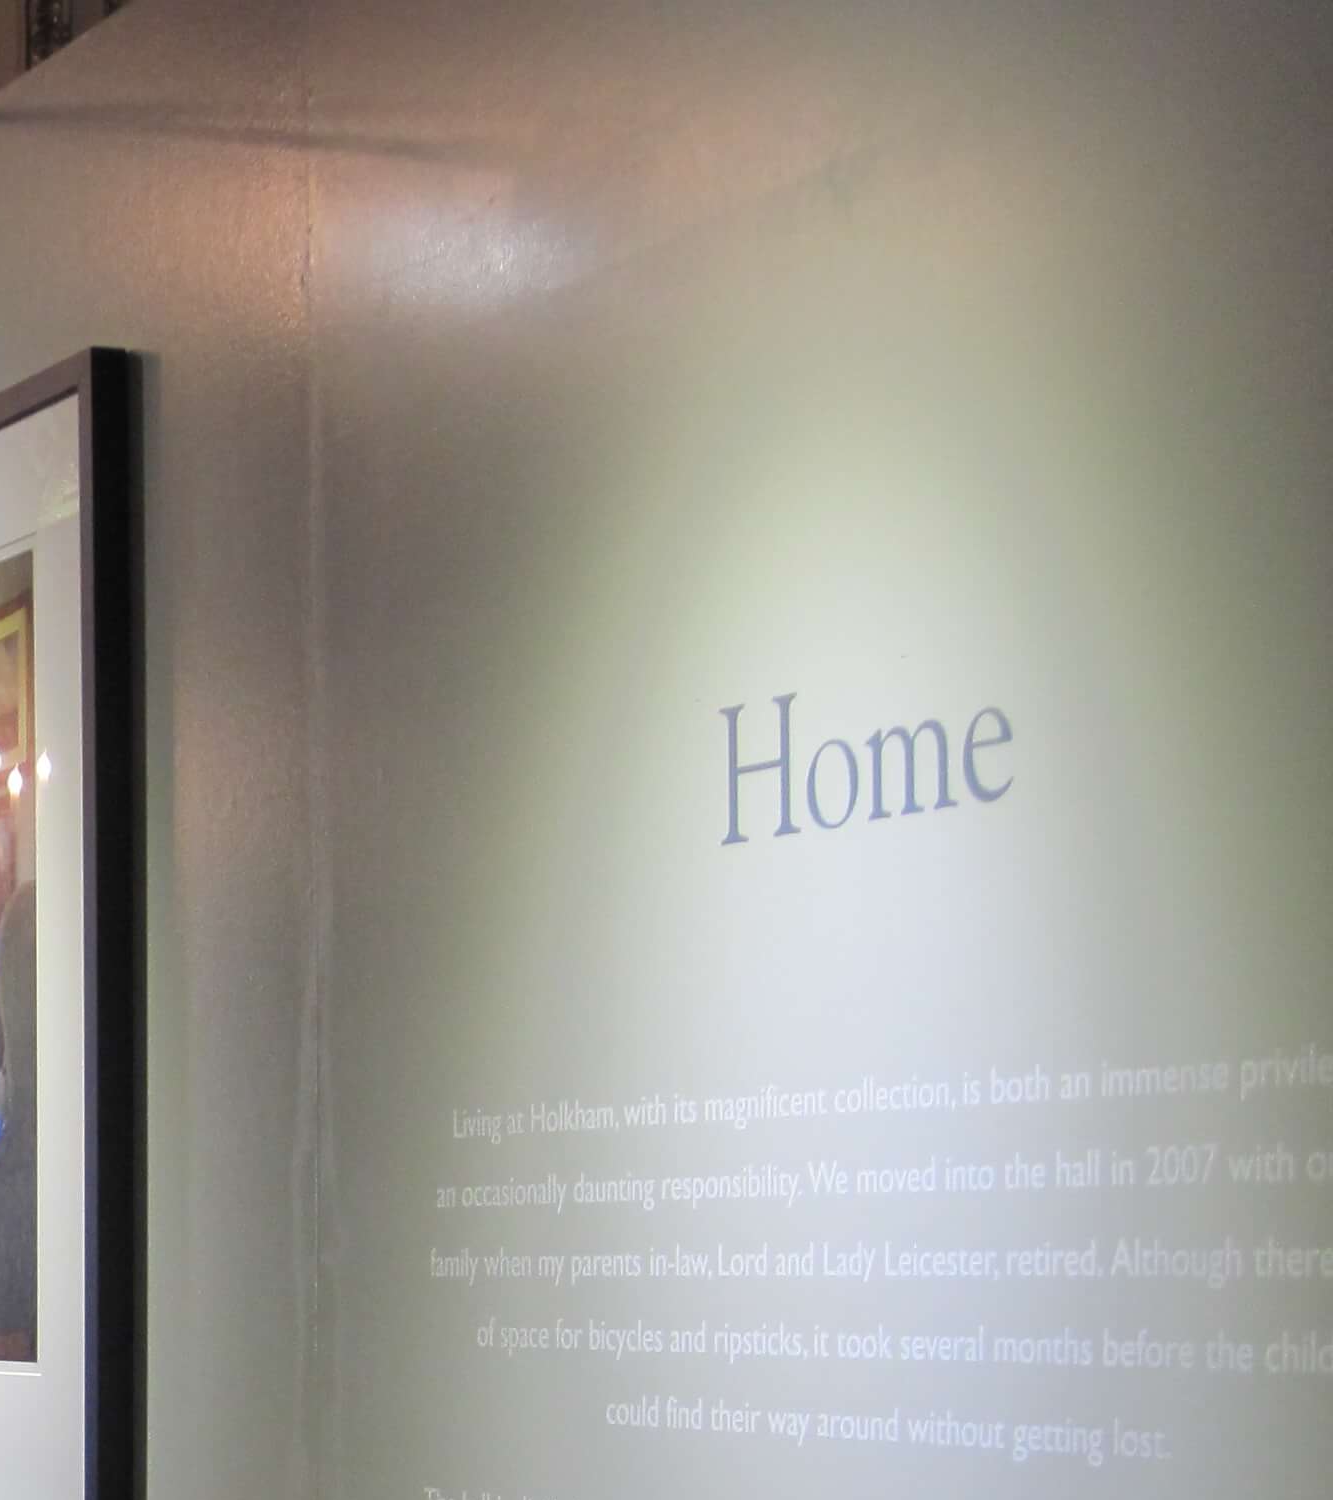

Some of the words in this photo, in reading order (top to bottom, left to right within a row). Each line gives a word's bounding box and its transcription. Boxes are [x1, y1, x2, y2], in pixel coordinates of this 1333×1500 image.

[719, 692, 1014, 846] Home
[453, 1109, 501, 1144] Living
[507, 1112, 524, 1135] at
[624, 1094, 666, 1126] with
[674, 1094, 697, 1123] its
[705, 1084, 827, 1130] magnificent
[963, 1072, 980, 1105] is
[991, 1064, 1050, 1104] both
[1060, 1073, 1090, 1099] an
[1102, 1062, 1229, 1096] immense
[437, 1187, 456, 1208] an
[462, 1174, 566, 1214] occasionally
[574, 1173, 655, 1211] daunting
[808, 1160, 848, 1194] We
[857, 1156, 936, 1193] moved
[946, 1158, 994, 1191] into
[1005, 1152, 1045, 1189] the
[1056, 1150, 1100, 1187] hall
[1112, 1151, 1134, 1185] in
[1147, 1143, 1217, 1185] 2007
[1229, 1143, 1294, 1183] with
[431, 1248, 478, 1286] family
[484, 1247, 531, 1276] when
[538, 1256, 564, 1286] my
[571, 1254, 641, 1284] parents
[718, 1243, 767, 1276] Lord
[776, 1242, 814, 1276] and
[824, 1241, 876, 1282] Lady
[1111, 1236, 1242, 1288] Although
[477, 1317, 495, 1347] of
[501, 1328, 549, 1357] space
[555, 1319, 582, 1349] for
[589, 1320, 663, 1360] bicycles
[670, 1321, 706, 1352] and
[814, 1325, 829, 1357] it
[838, 1324, 892, 1358] took
[901, 1325, 984, 1361] several
[994, 1328, 1092, 1366] months
[1103, 1328, 1193, 1368] before
[1207, 1331, 1253, 1373] the
[606, 1396, 659, 1427] could
[666, 1396, 702, 1430] find
[711, 1400, 761, 1432] their
[768, 1412, 810, 1446] way
[817, 1408, 898, 1441] around
[908, 1411, 1004, 1448] without
[1013, 1425, 1103, 1467] getting
